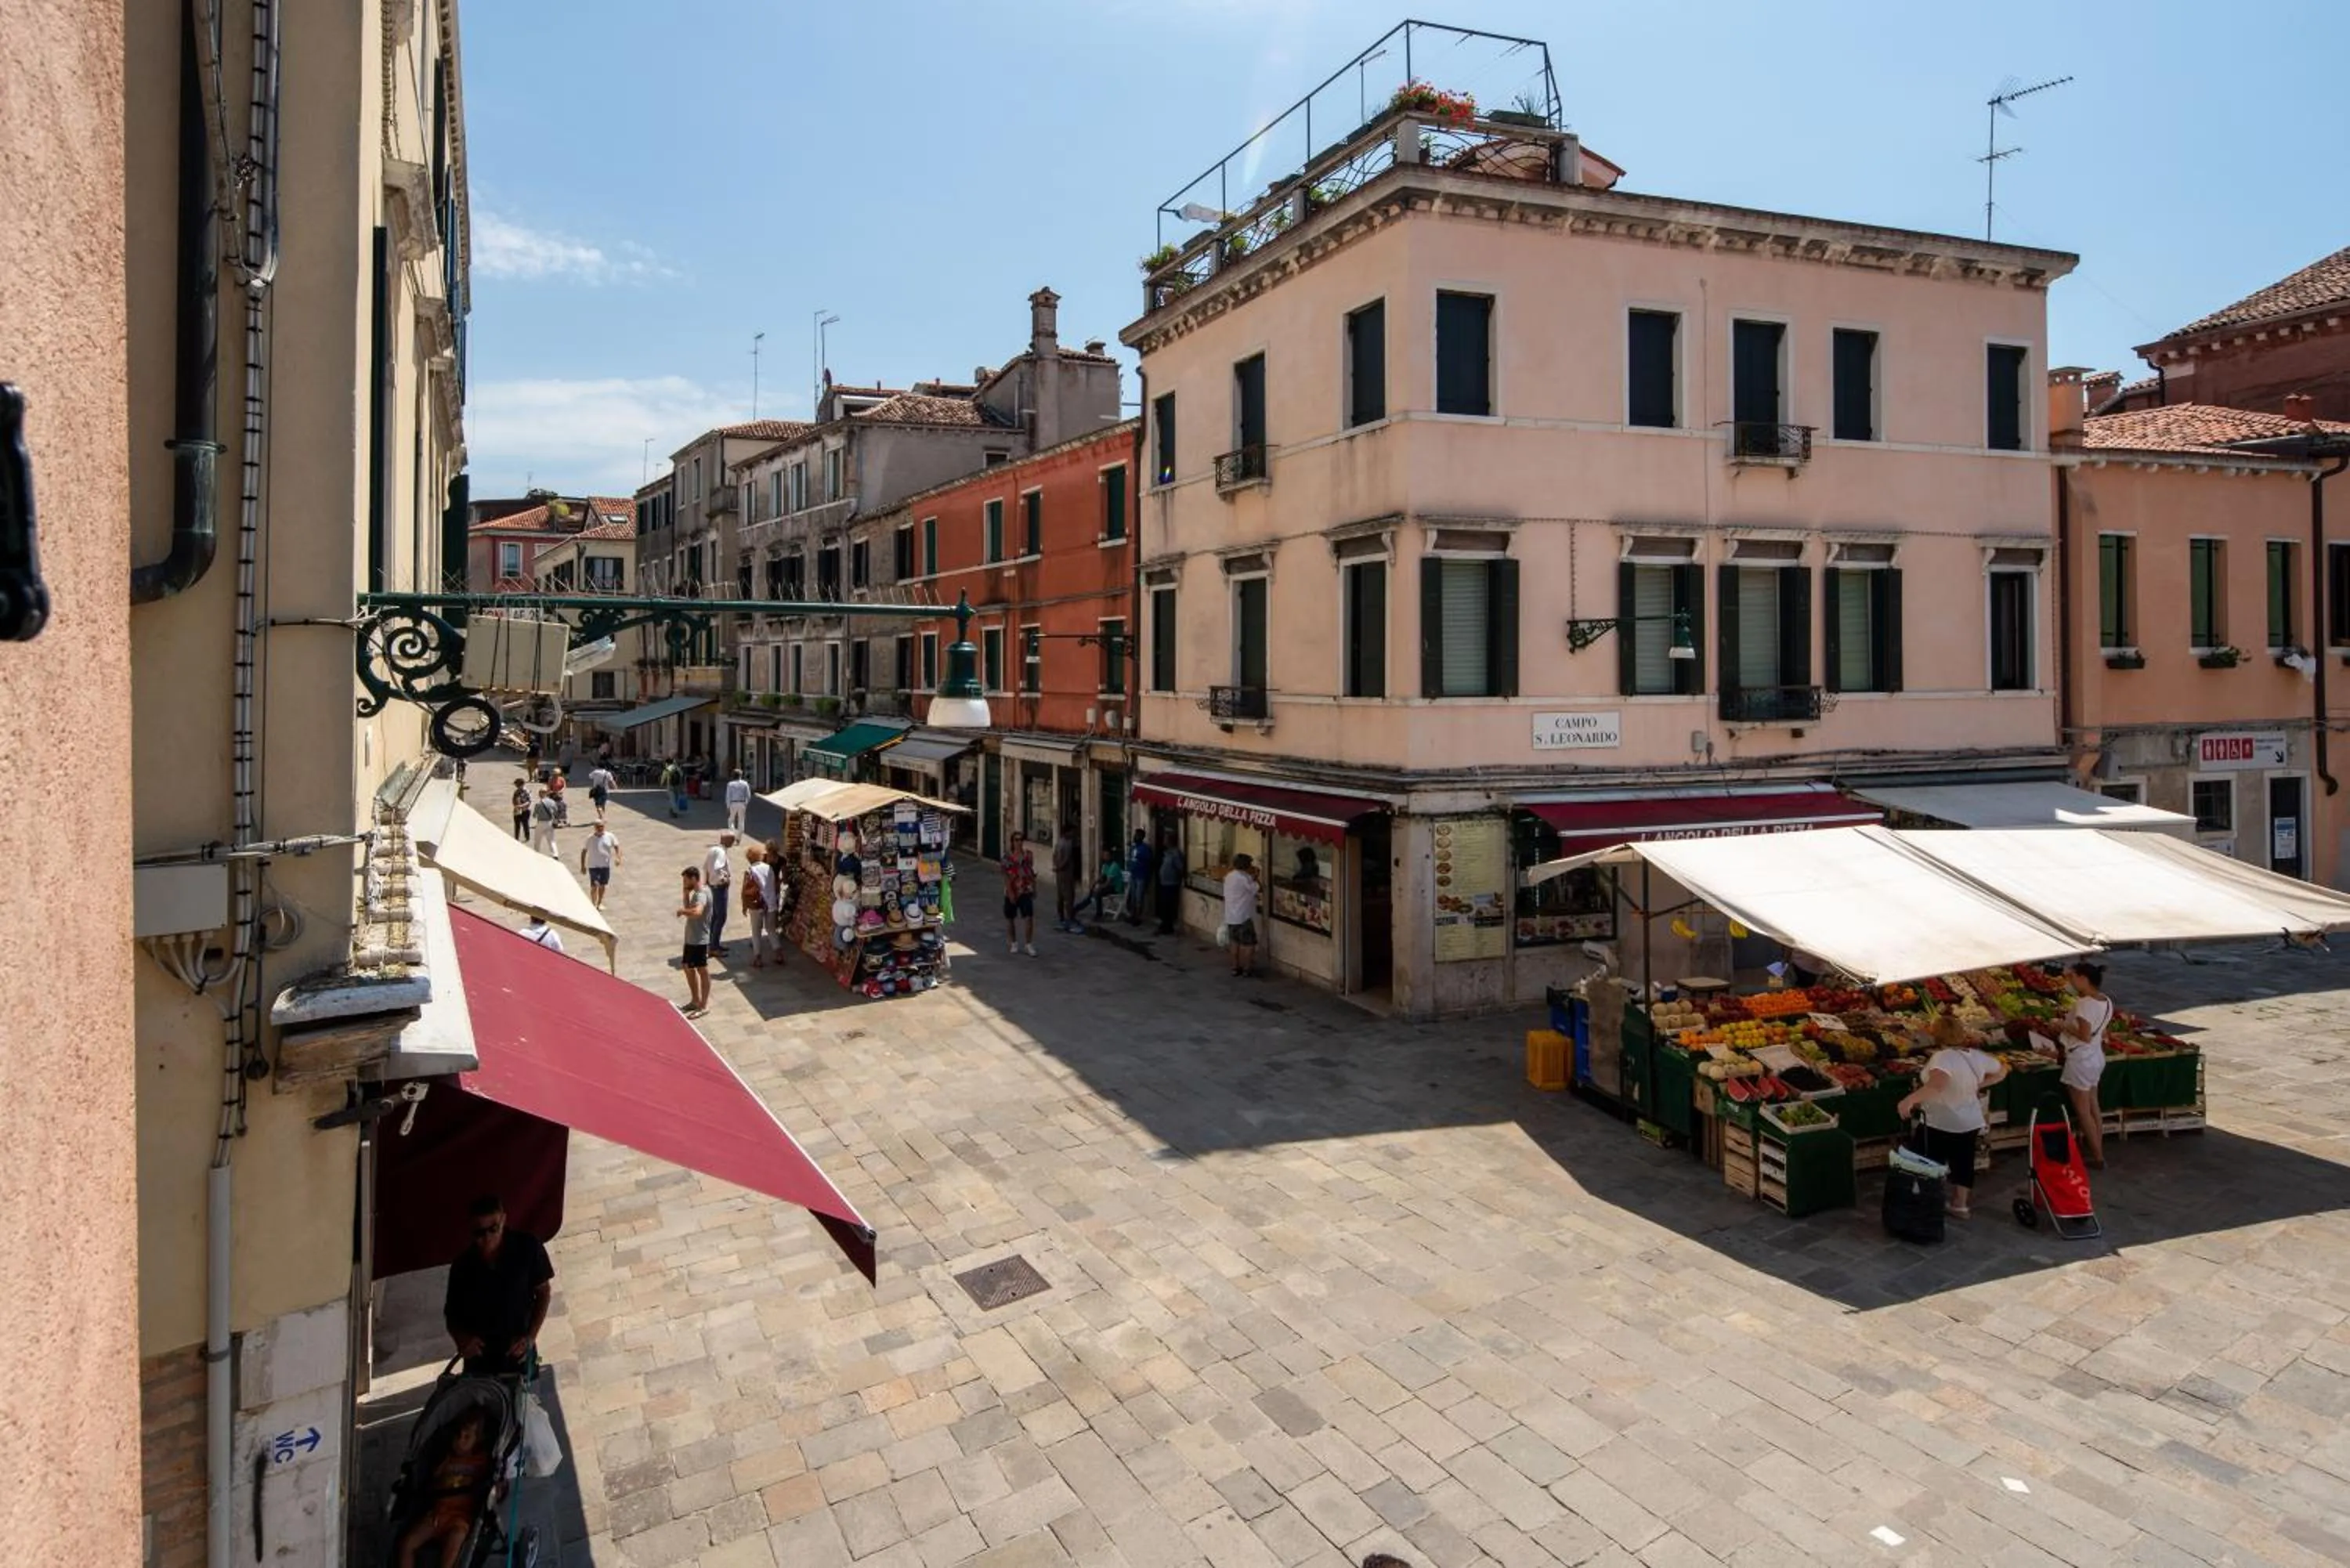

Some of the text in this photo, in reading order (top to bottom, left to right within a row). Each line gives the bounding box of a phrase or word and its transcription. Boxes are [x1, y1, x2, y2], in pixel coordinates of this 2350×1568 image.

[1555, 717, 1597, 728] CAMPO
[1218, 805, 1247, 821] DELLA
[1249, 812, 1277, 827] PIZZA
[275, 1429, 295, 1463] WC
